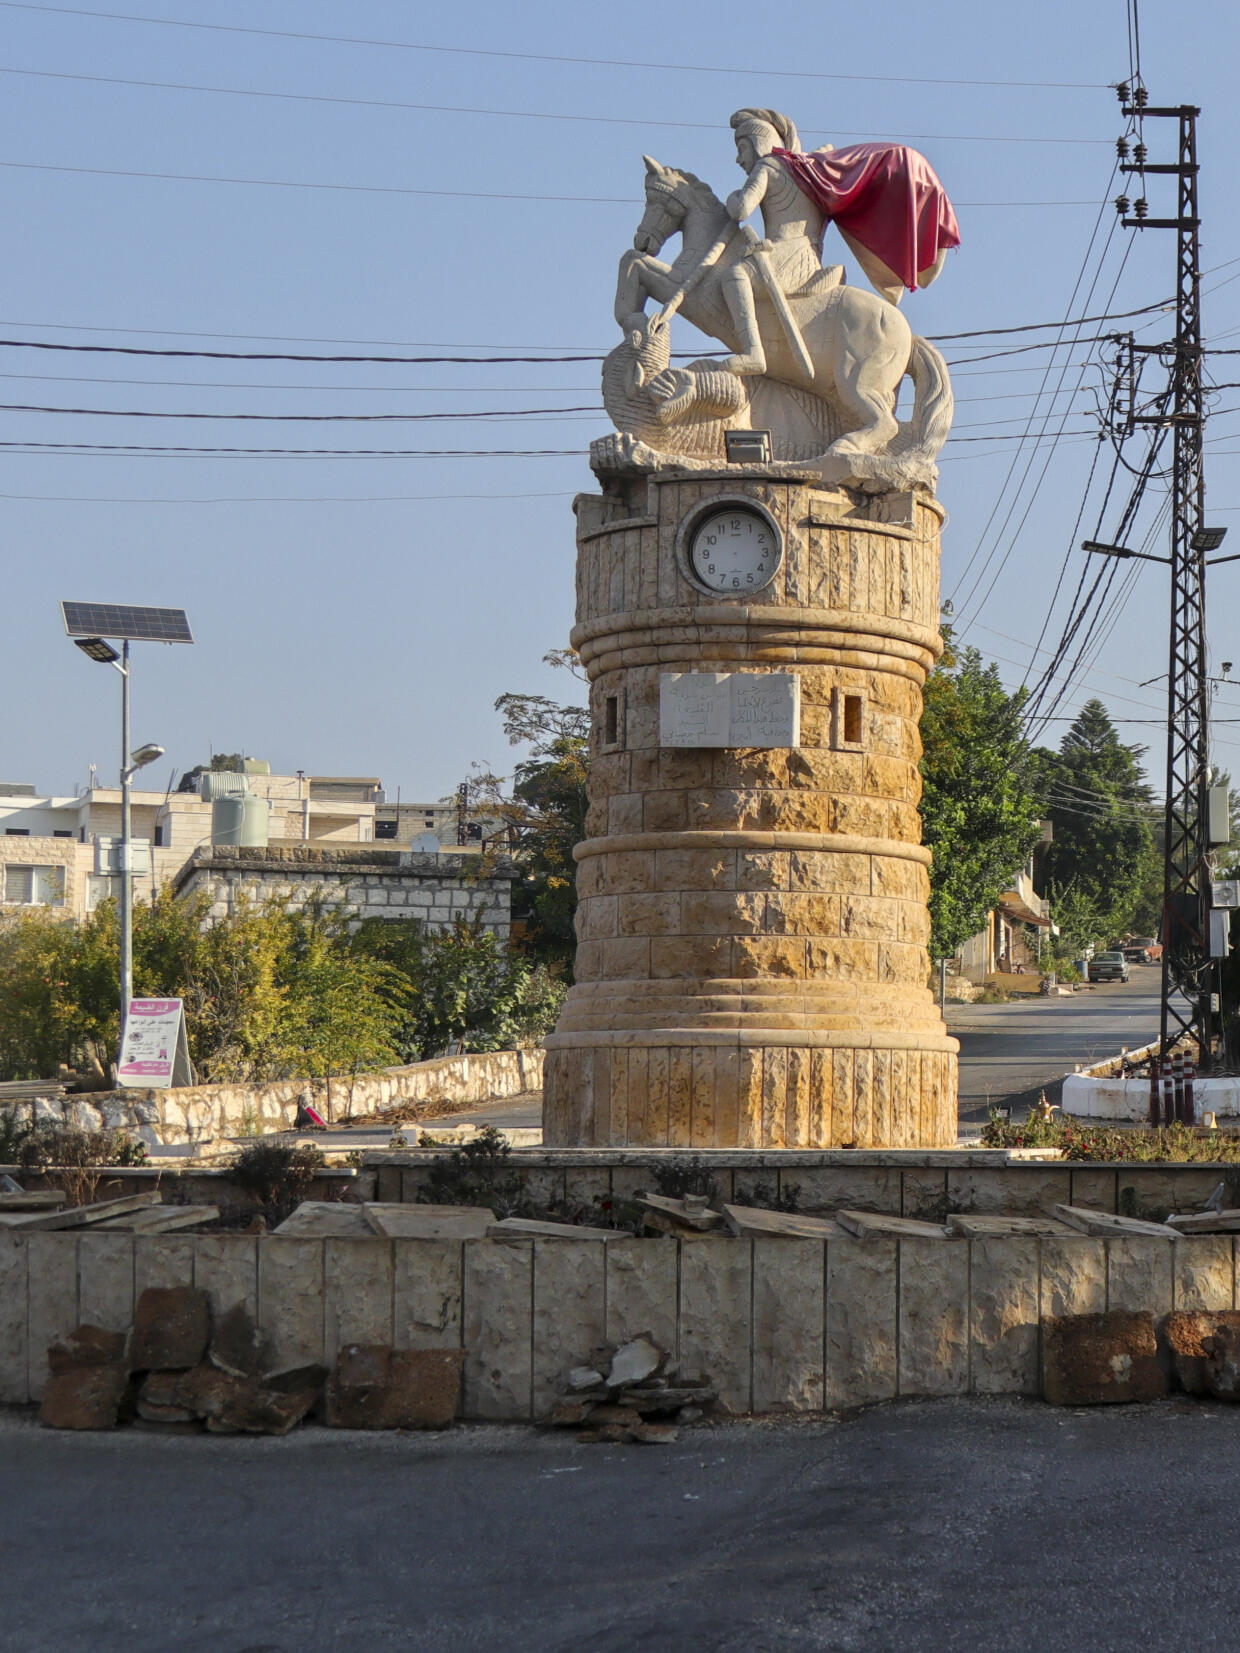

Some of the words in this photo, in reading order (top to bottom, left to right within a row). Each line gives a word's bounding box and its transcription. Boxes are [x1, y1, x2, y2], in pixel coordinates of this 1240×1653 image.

[718, 524, 725, 534] 11
[730, 519, 741, 530] 12
[707, 535, 717, 545] 10
[758, 534, 765, 544] 2
[702, 549, 710, 559] 9
[761, 547, 769, 558] 3
[708, 563, 715, 574] 8
[757, 562, 764, 572] 4
[719, 574, 726, 584] 7
[732, 577, 740, 587] 6
[746, 573, 754, 583] 5
